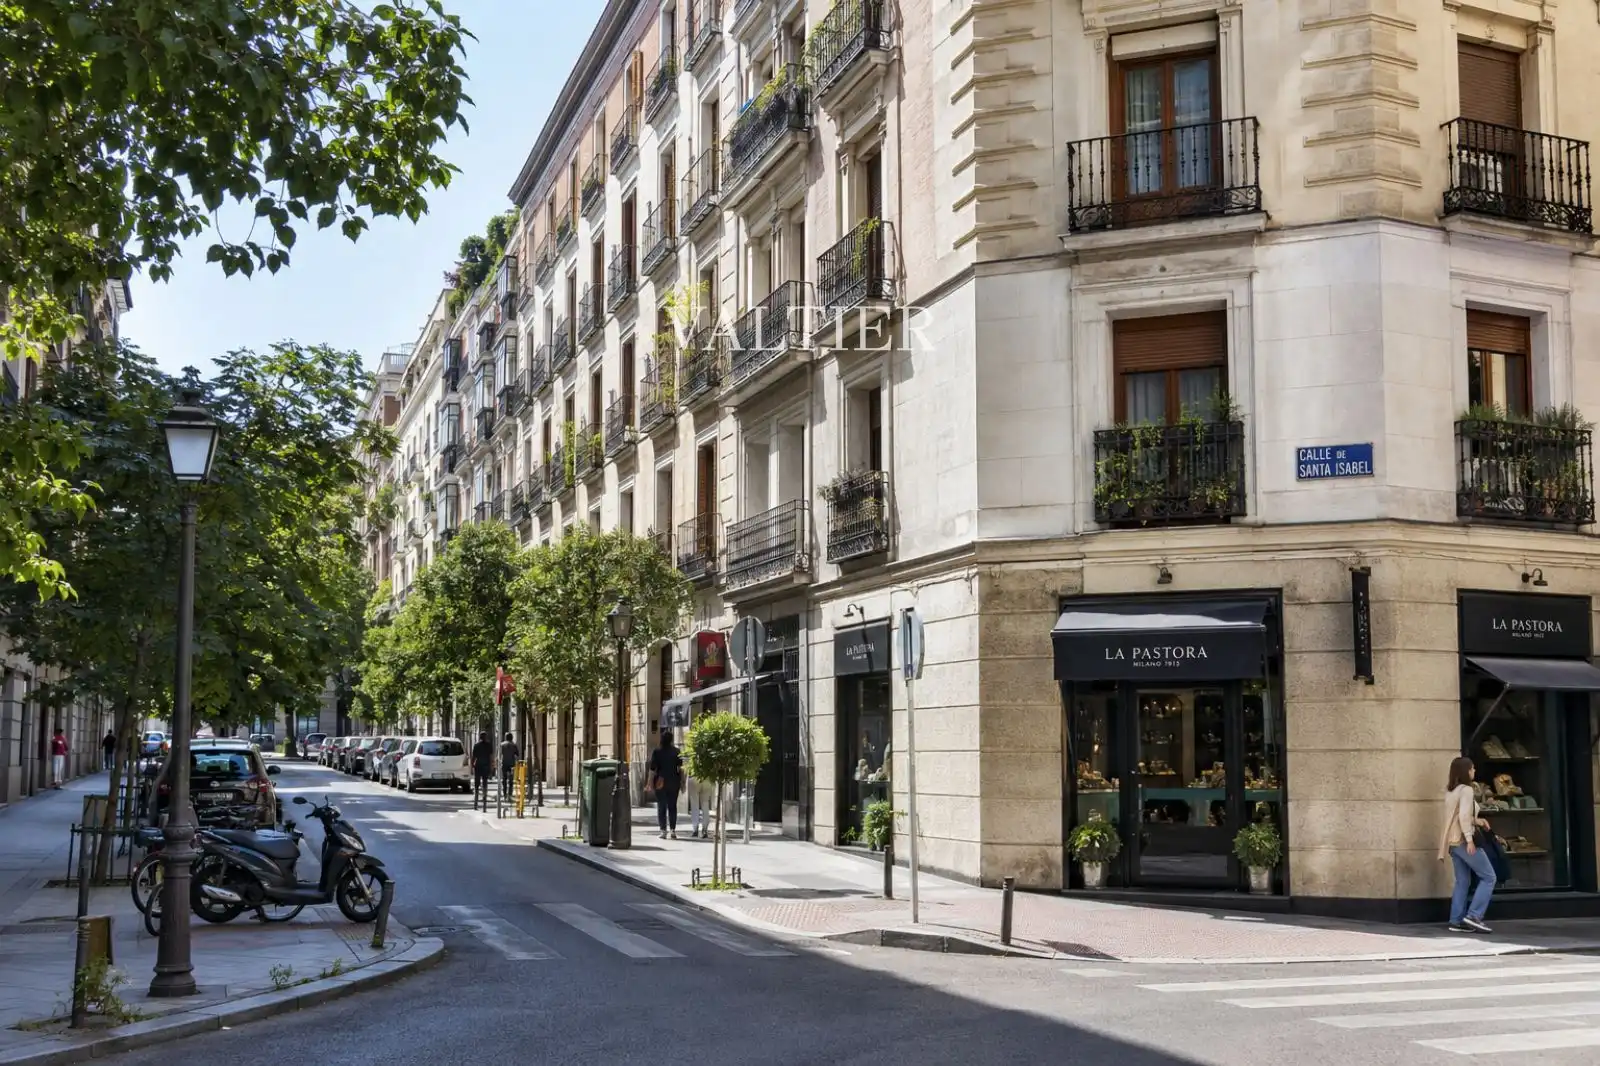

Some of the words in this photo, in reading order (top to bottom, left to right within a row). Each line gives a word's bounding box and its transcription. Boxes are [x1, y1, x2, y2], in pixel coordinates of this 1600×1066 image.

[1299, 447, 1331, 461] CALLE
[1336, 450, 1347, 459] DE
[1299, 463, 1331, 477] SANTA
[1335, 461, 1372, 475] ISABEL
[1492, 618, 1508, 630] LA
[1511, 618, 1563, 632] PASTORA
[1105, 647, 1125, 660] LA
[1132, 646, 1208, 659] PASTORA
[1133, 660, 1161, 668] MILANO
